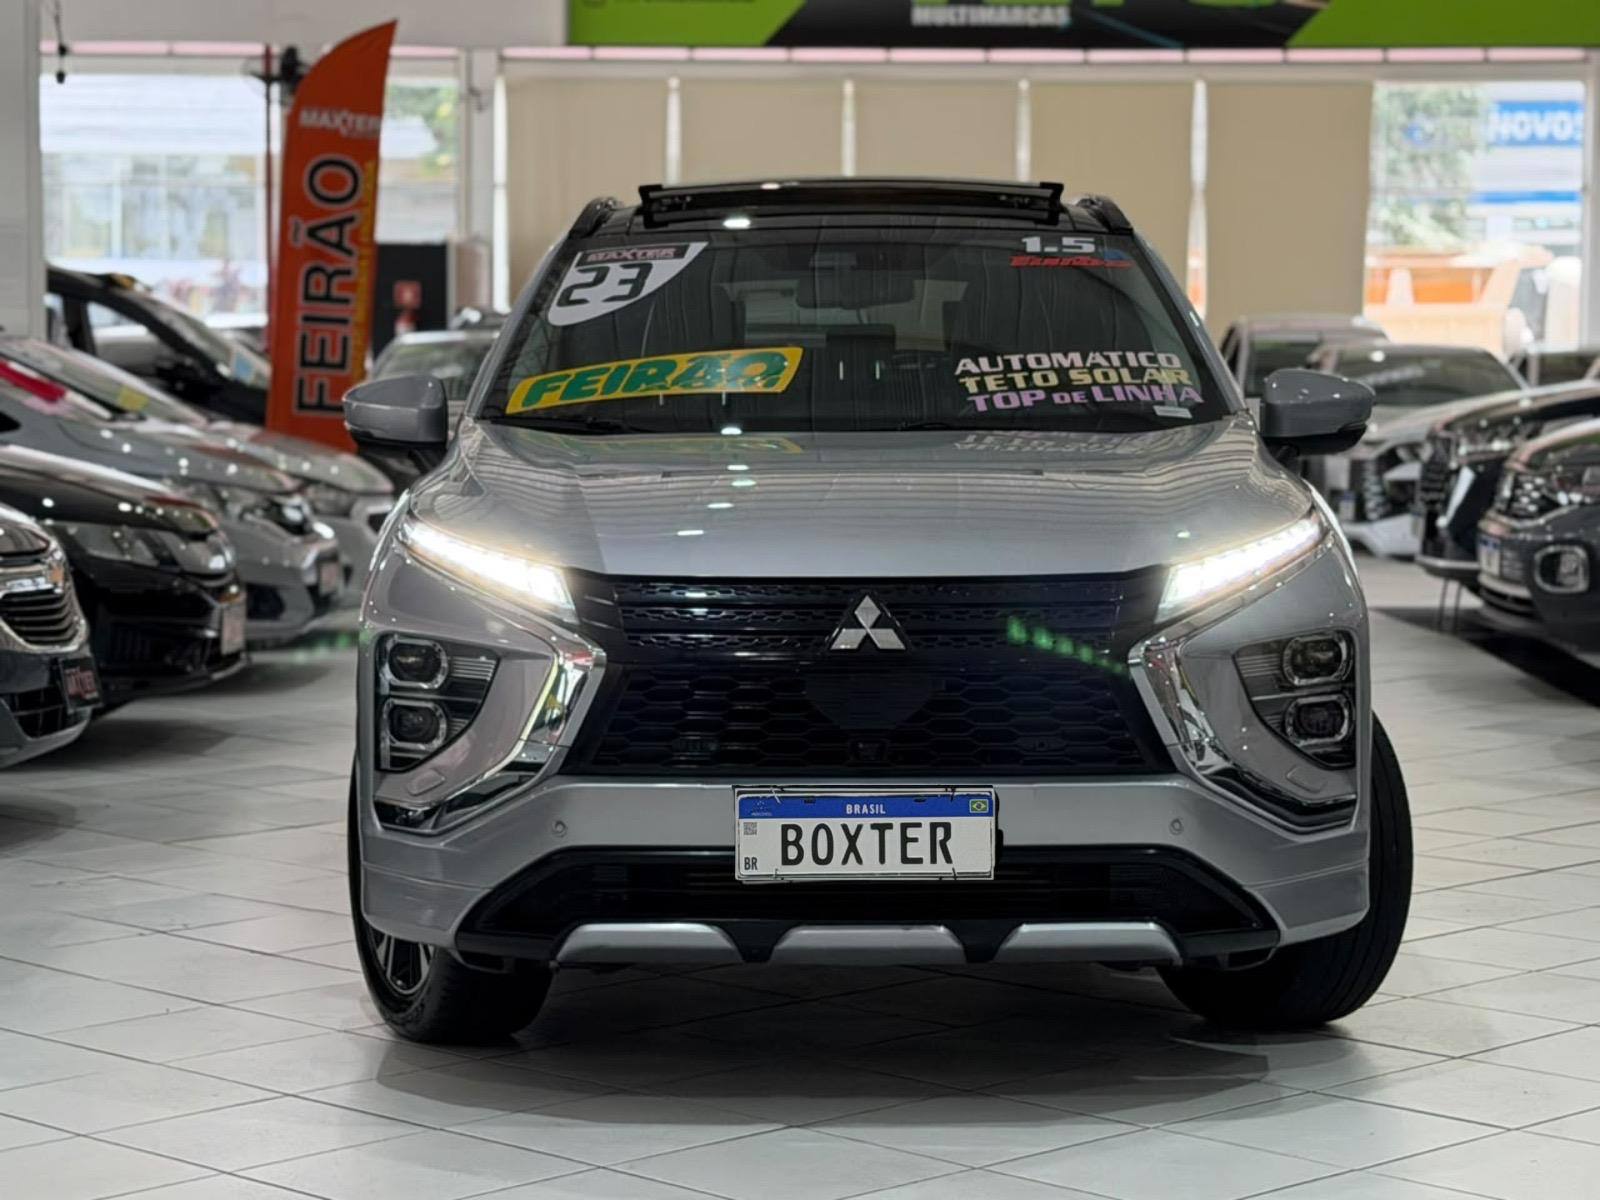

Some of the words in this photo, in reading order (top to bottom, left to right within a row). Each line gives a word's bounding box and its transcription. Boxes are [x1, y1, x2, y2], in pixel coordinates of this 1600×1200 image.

[911, 6, 1069, 27] MULTIMARCAS
[1021, 236, 1095, 253] 1.5
[289, 155, 362, 413] FEIRÃO
[555, 262, 653, 307] 23
[959, 370, 1059, 393] TETO
[1068, 367, 1192, 386] SOLAR
[967, 389, 1046, 413] TOP
[1091, 384, 1204, 404] LINHA
[846, 803, 886, 815] BRASIL
[780, 822, 953, 866] BOXTER
[744, 856, 758, 871] BR
